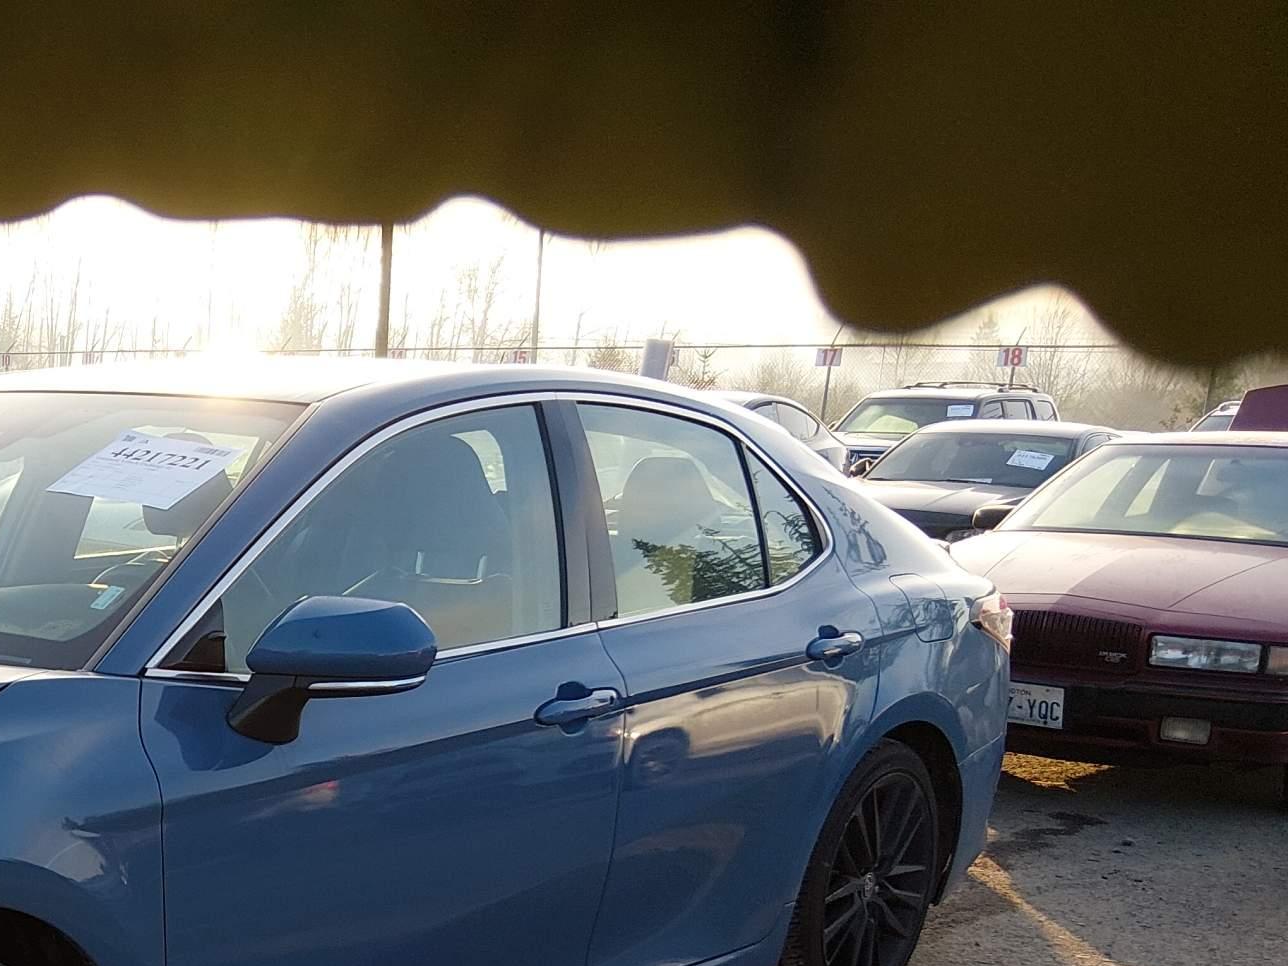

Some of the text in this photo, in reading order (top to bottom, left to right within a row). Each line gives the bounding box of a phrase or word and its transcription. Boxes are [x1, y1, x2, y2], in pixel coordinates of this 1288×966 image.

[1, 354, 11, 367] 10
[513, 351, 527, 364] 15
[822, 348, 838, 366] 17
[1003, 347, 1023, 366] 18
[111, 447, 211, 470] 44217221
